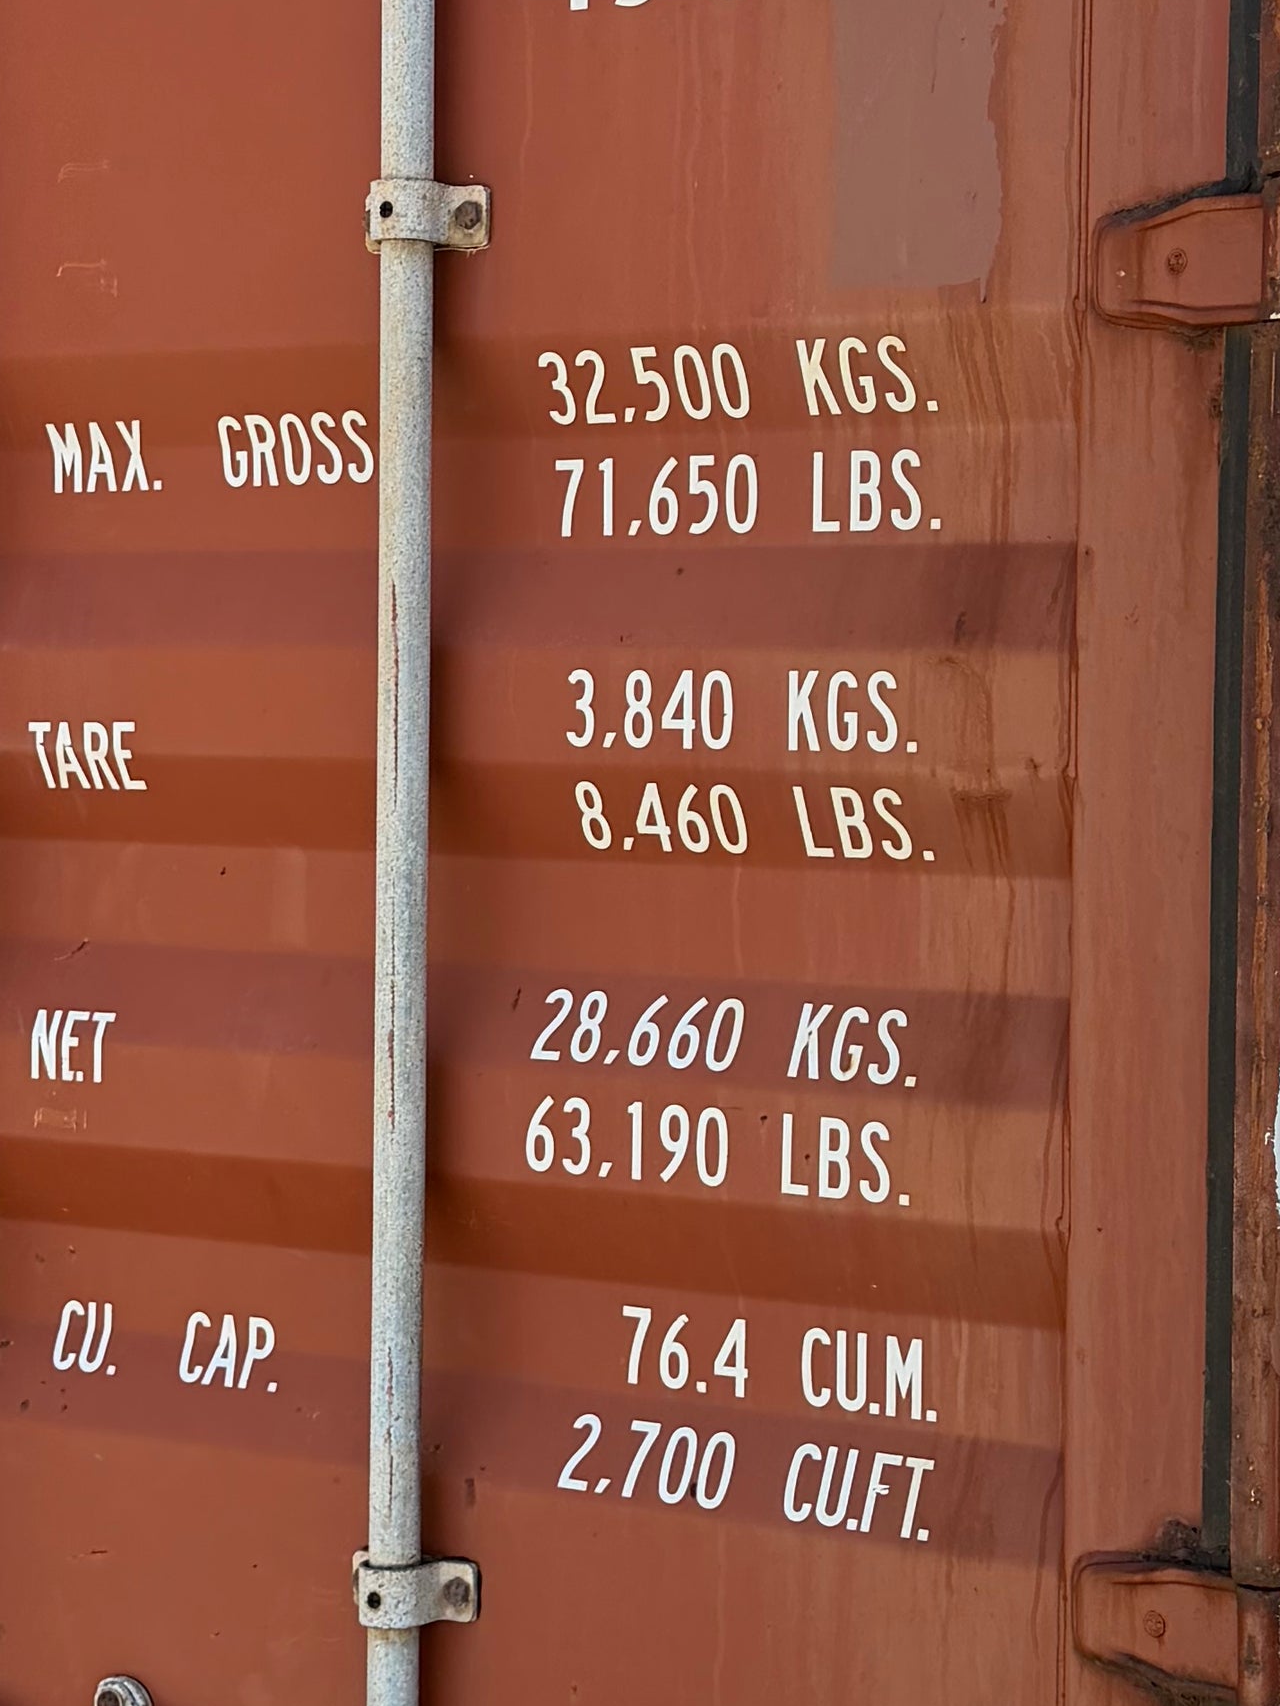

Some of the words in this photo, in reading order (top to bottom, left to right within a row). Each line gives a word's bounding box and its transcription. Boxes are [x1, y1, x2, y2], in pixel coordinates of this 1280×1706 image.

[46, 419, 163, 494] MAX.
[219, 410, 375, 488] GROSS
[538, 343, 750, 427] 32,500
[795, 336, 940, 417] KGS.
[556, 453, 759, 538] 71,650
[812, 449, 942, 534] LBS.
[28, 720, 148, 792] TARE
[566, 669, 734, 751] 3,840
[788, 670, 920, 753] KGS.
[575, 781, 748, 856] 8,460
[792, 786, 936, 862] LBS.
[30, 1008, 117, 1084] NET
[530, 988, 745, 1073] 28,660
[787, 1002, 918, 1088] KGS.
[525, 1095, 729, 1189] 63,190
[780, 1112, 911, 1207] LBS.
[53, 1300, 117, 1376] CU.
[179, 1311, 278, 1393] CAP.
[621, 1306, 748, 1398] 76.4
[801, 1326, 939, 1422] CU.M.
[558, 1413, 736, 1511] 2,700
